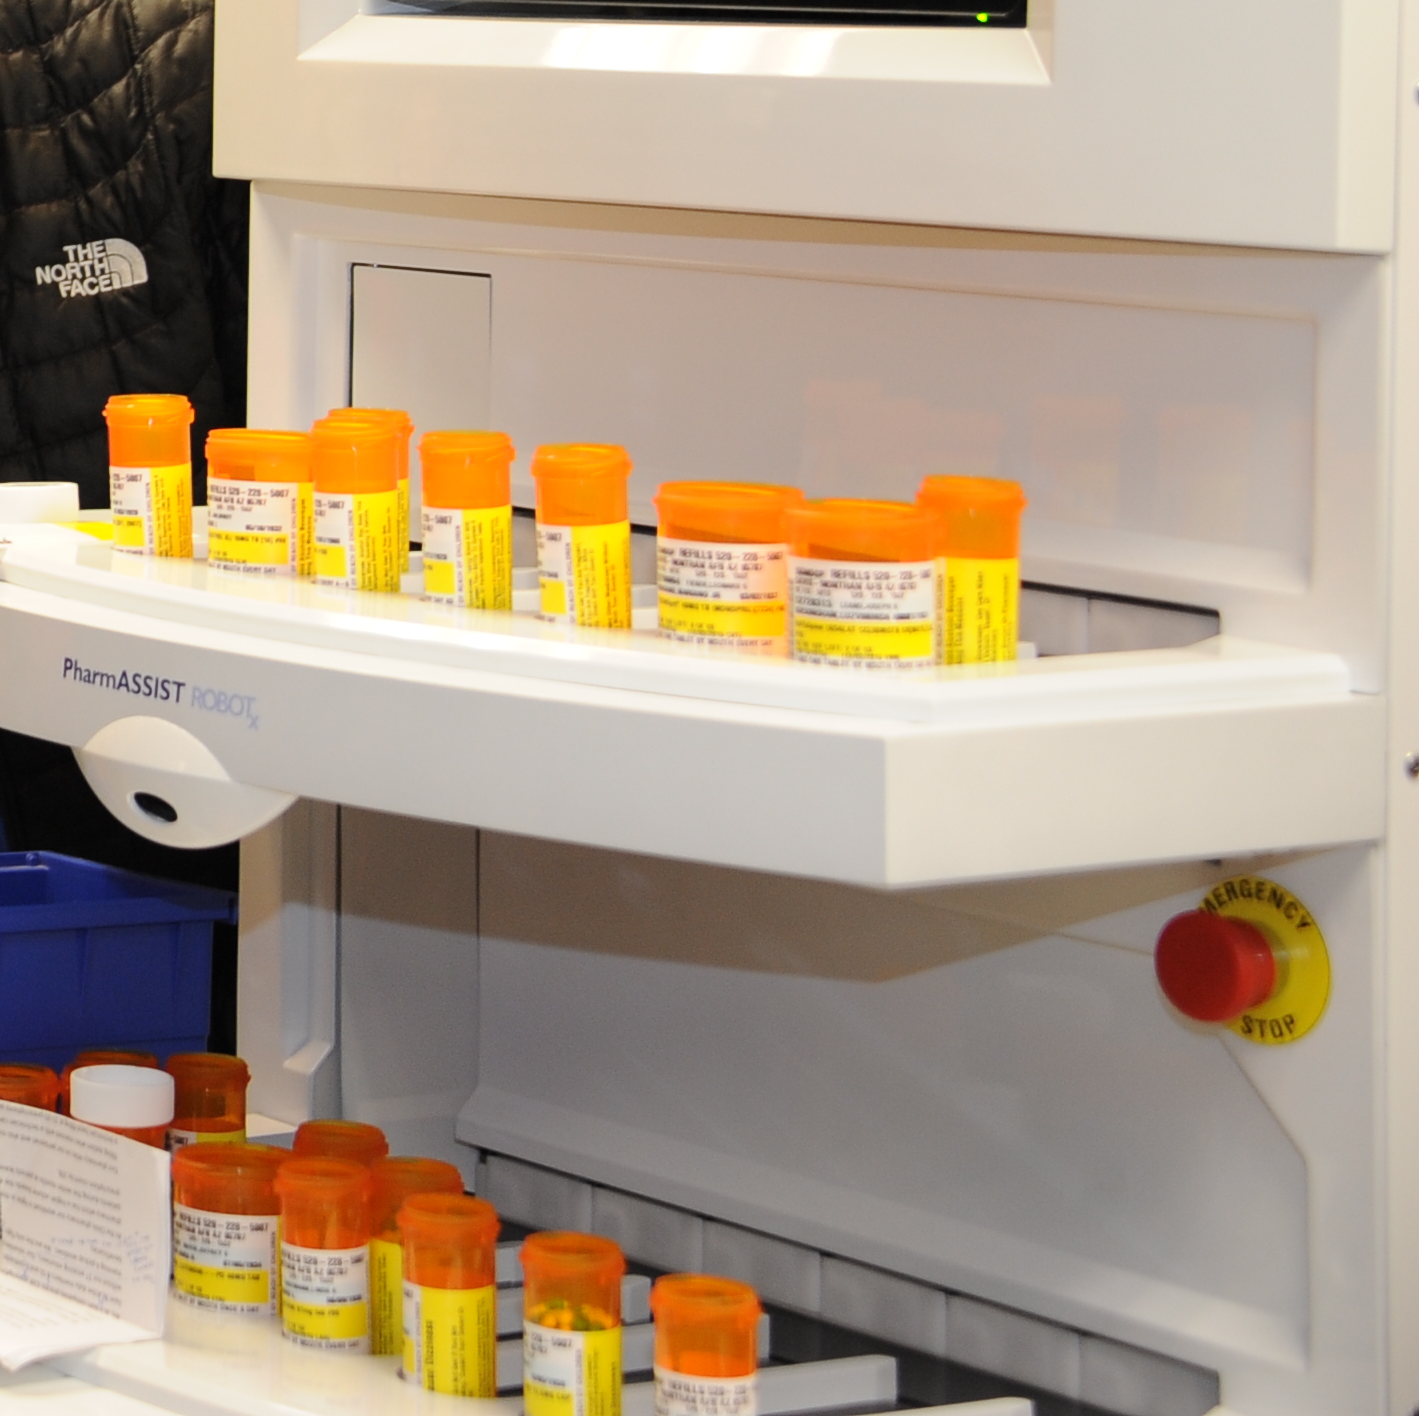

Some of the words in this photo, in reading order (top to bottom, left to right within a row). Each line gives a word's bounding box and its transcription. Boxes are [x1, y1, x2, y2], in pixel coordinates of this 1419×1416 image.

[63, 240, 106, 263] THE
[35, 259, 110, 285] NORTH
[58, 274, 114, 298] FACE
[63, 657, 186, 704] PharmASSIST
[1199, 878, 1311, 932] MERGENCY
[1241, 1013, 1295, 1039] STOP
